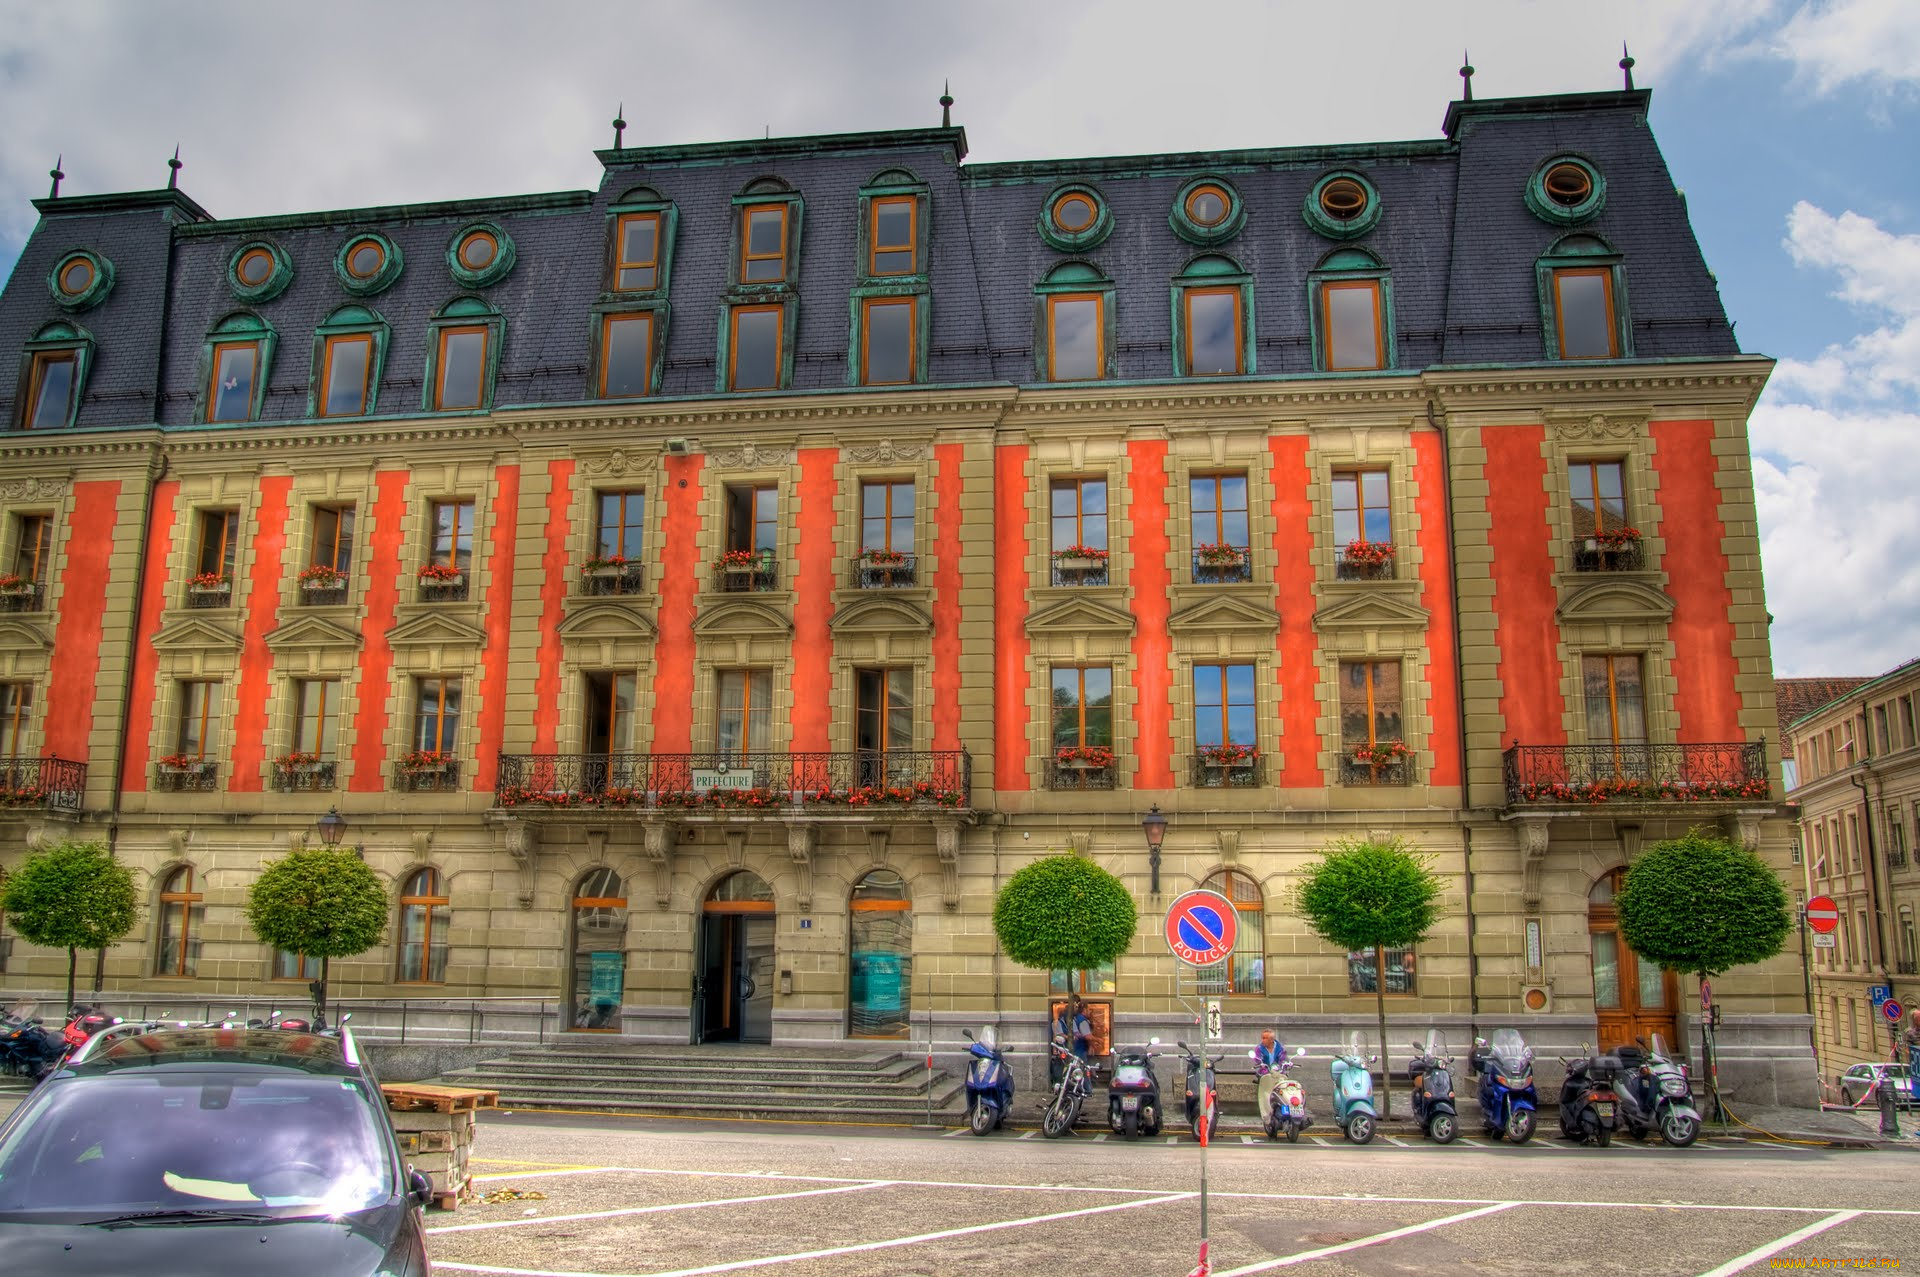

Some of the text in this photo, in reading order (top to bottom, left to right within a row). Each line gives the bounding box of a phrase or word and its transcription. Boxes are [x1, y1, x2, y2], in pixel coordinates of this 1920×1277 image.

[696, 776, 750, 787] PREFECTURE
[1173, 941, 1228, 962] POLICE
[1874, 987, 1884, 999] P
